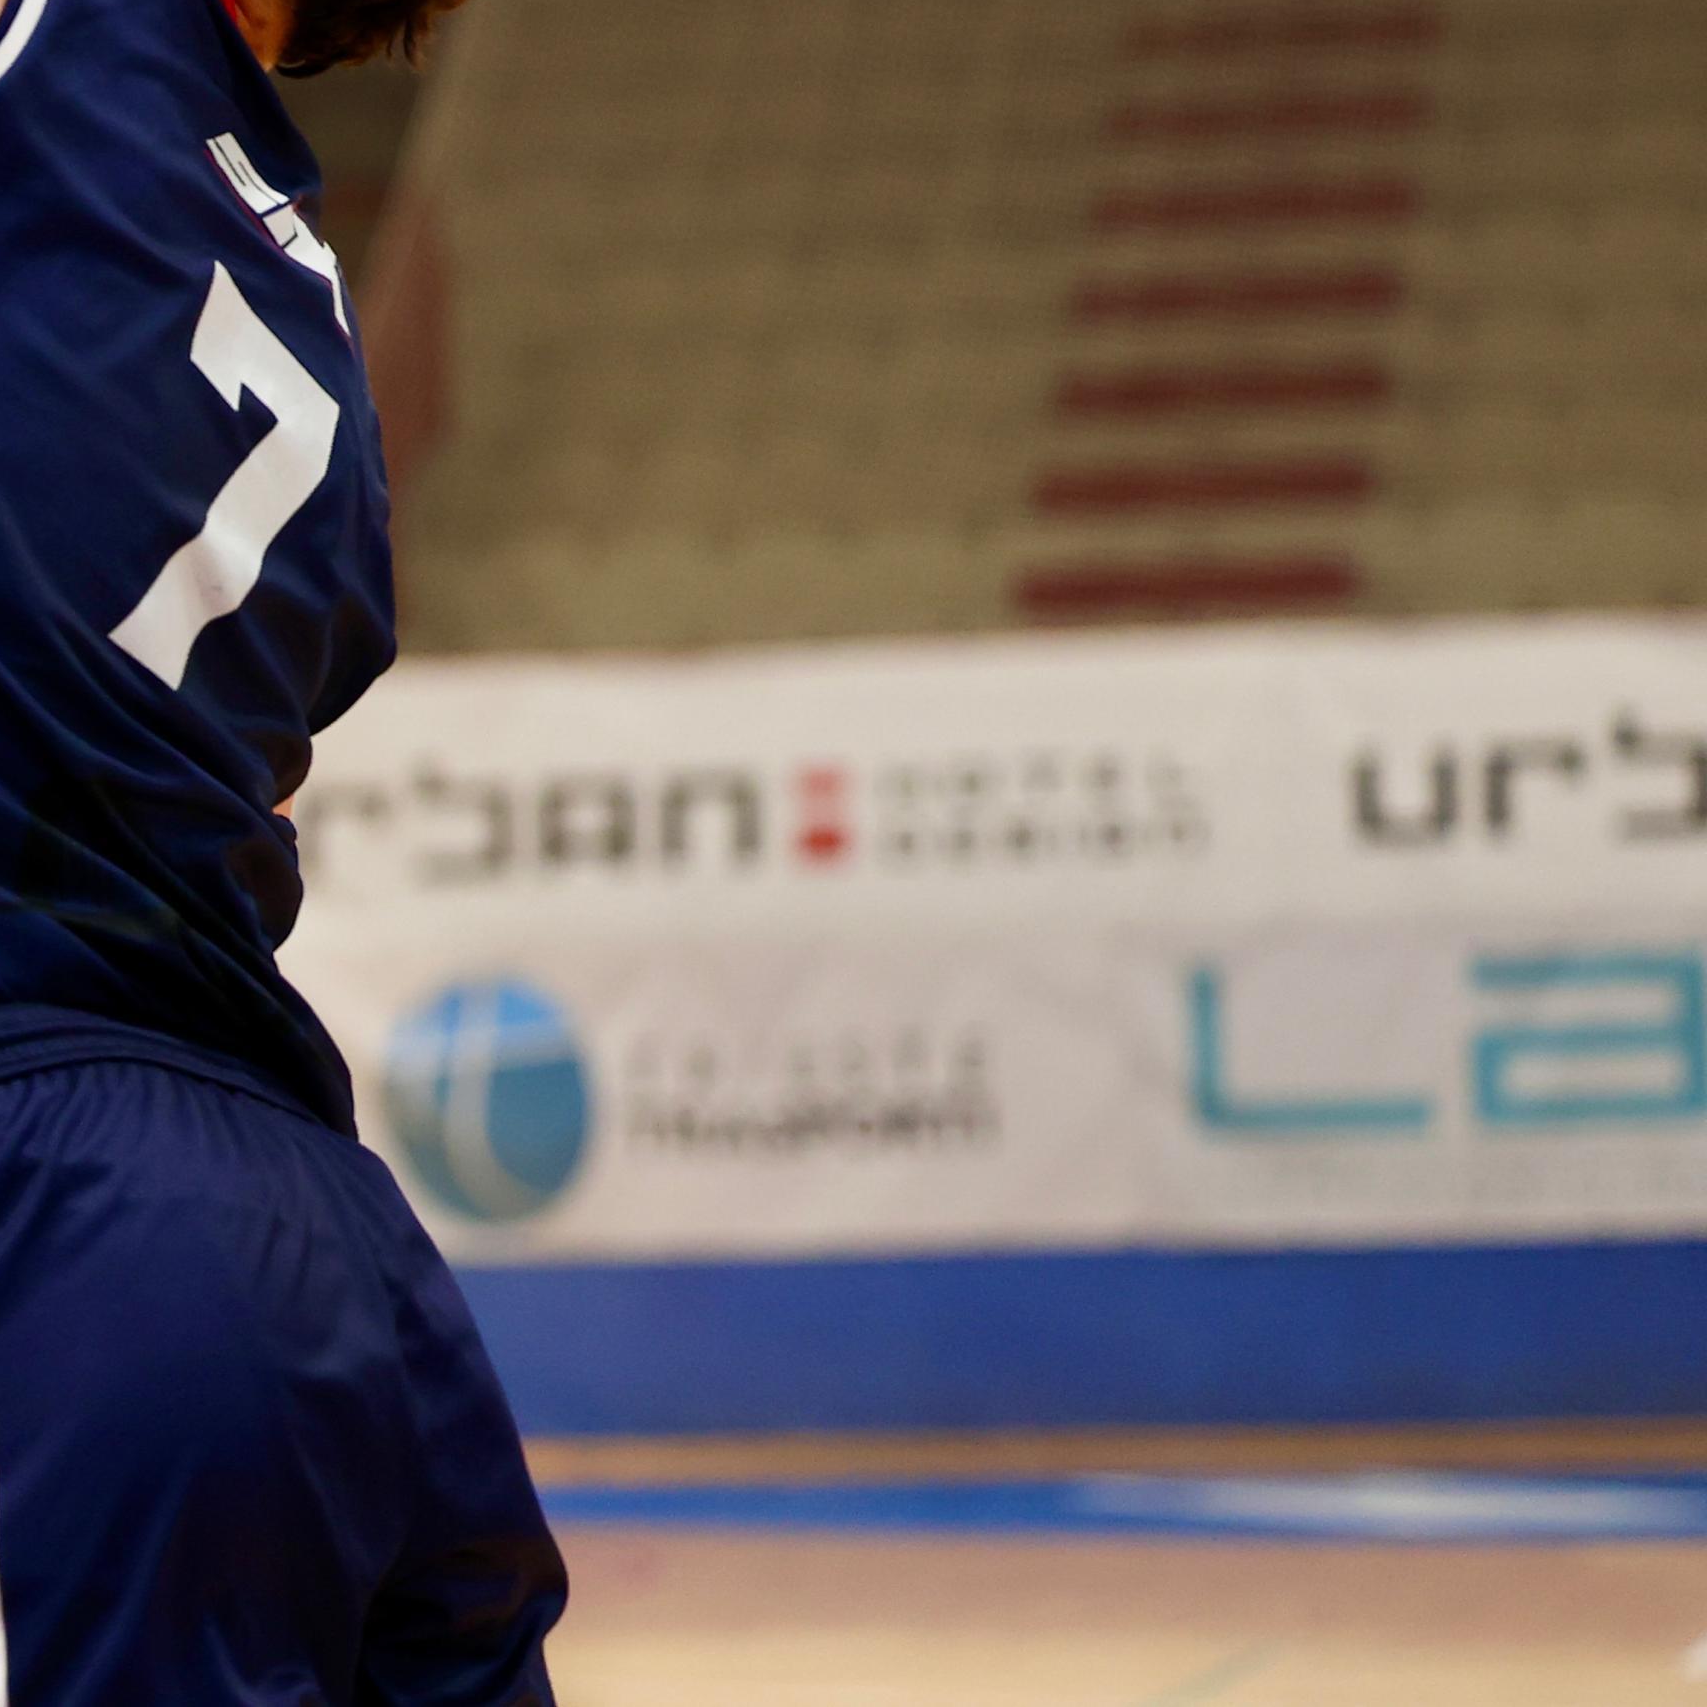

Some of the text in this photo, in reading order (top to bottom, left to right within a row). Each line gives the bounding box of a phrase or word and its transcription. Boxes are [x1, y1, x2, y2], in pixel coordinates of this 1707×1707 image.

[107, 259, 341, 692] 7
[293, 749, 763, 882] rban
[1350, 709, 1707, 850] urb
